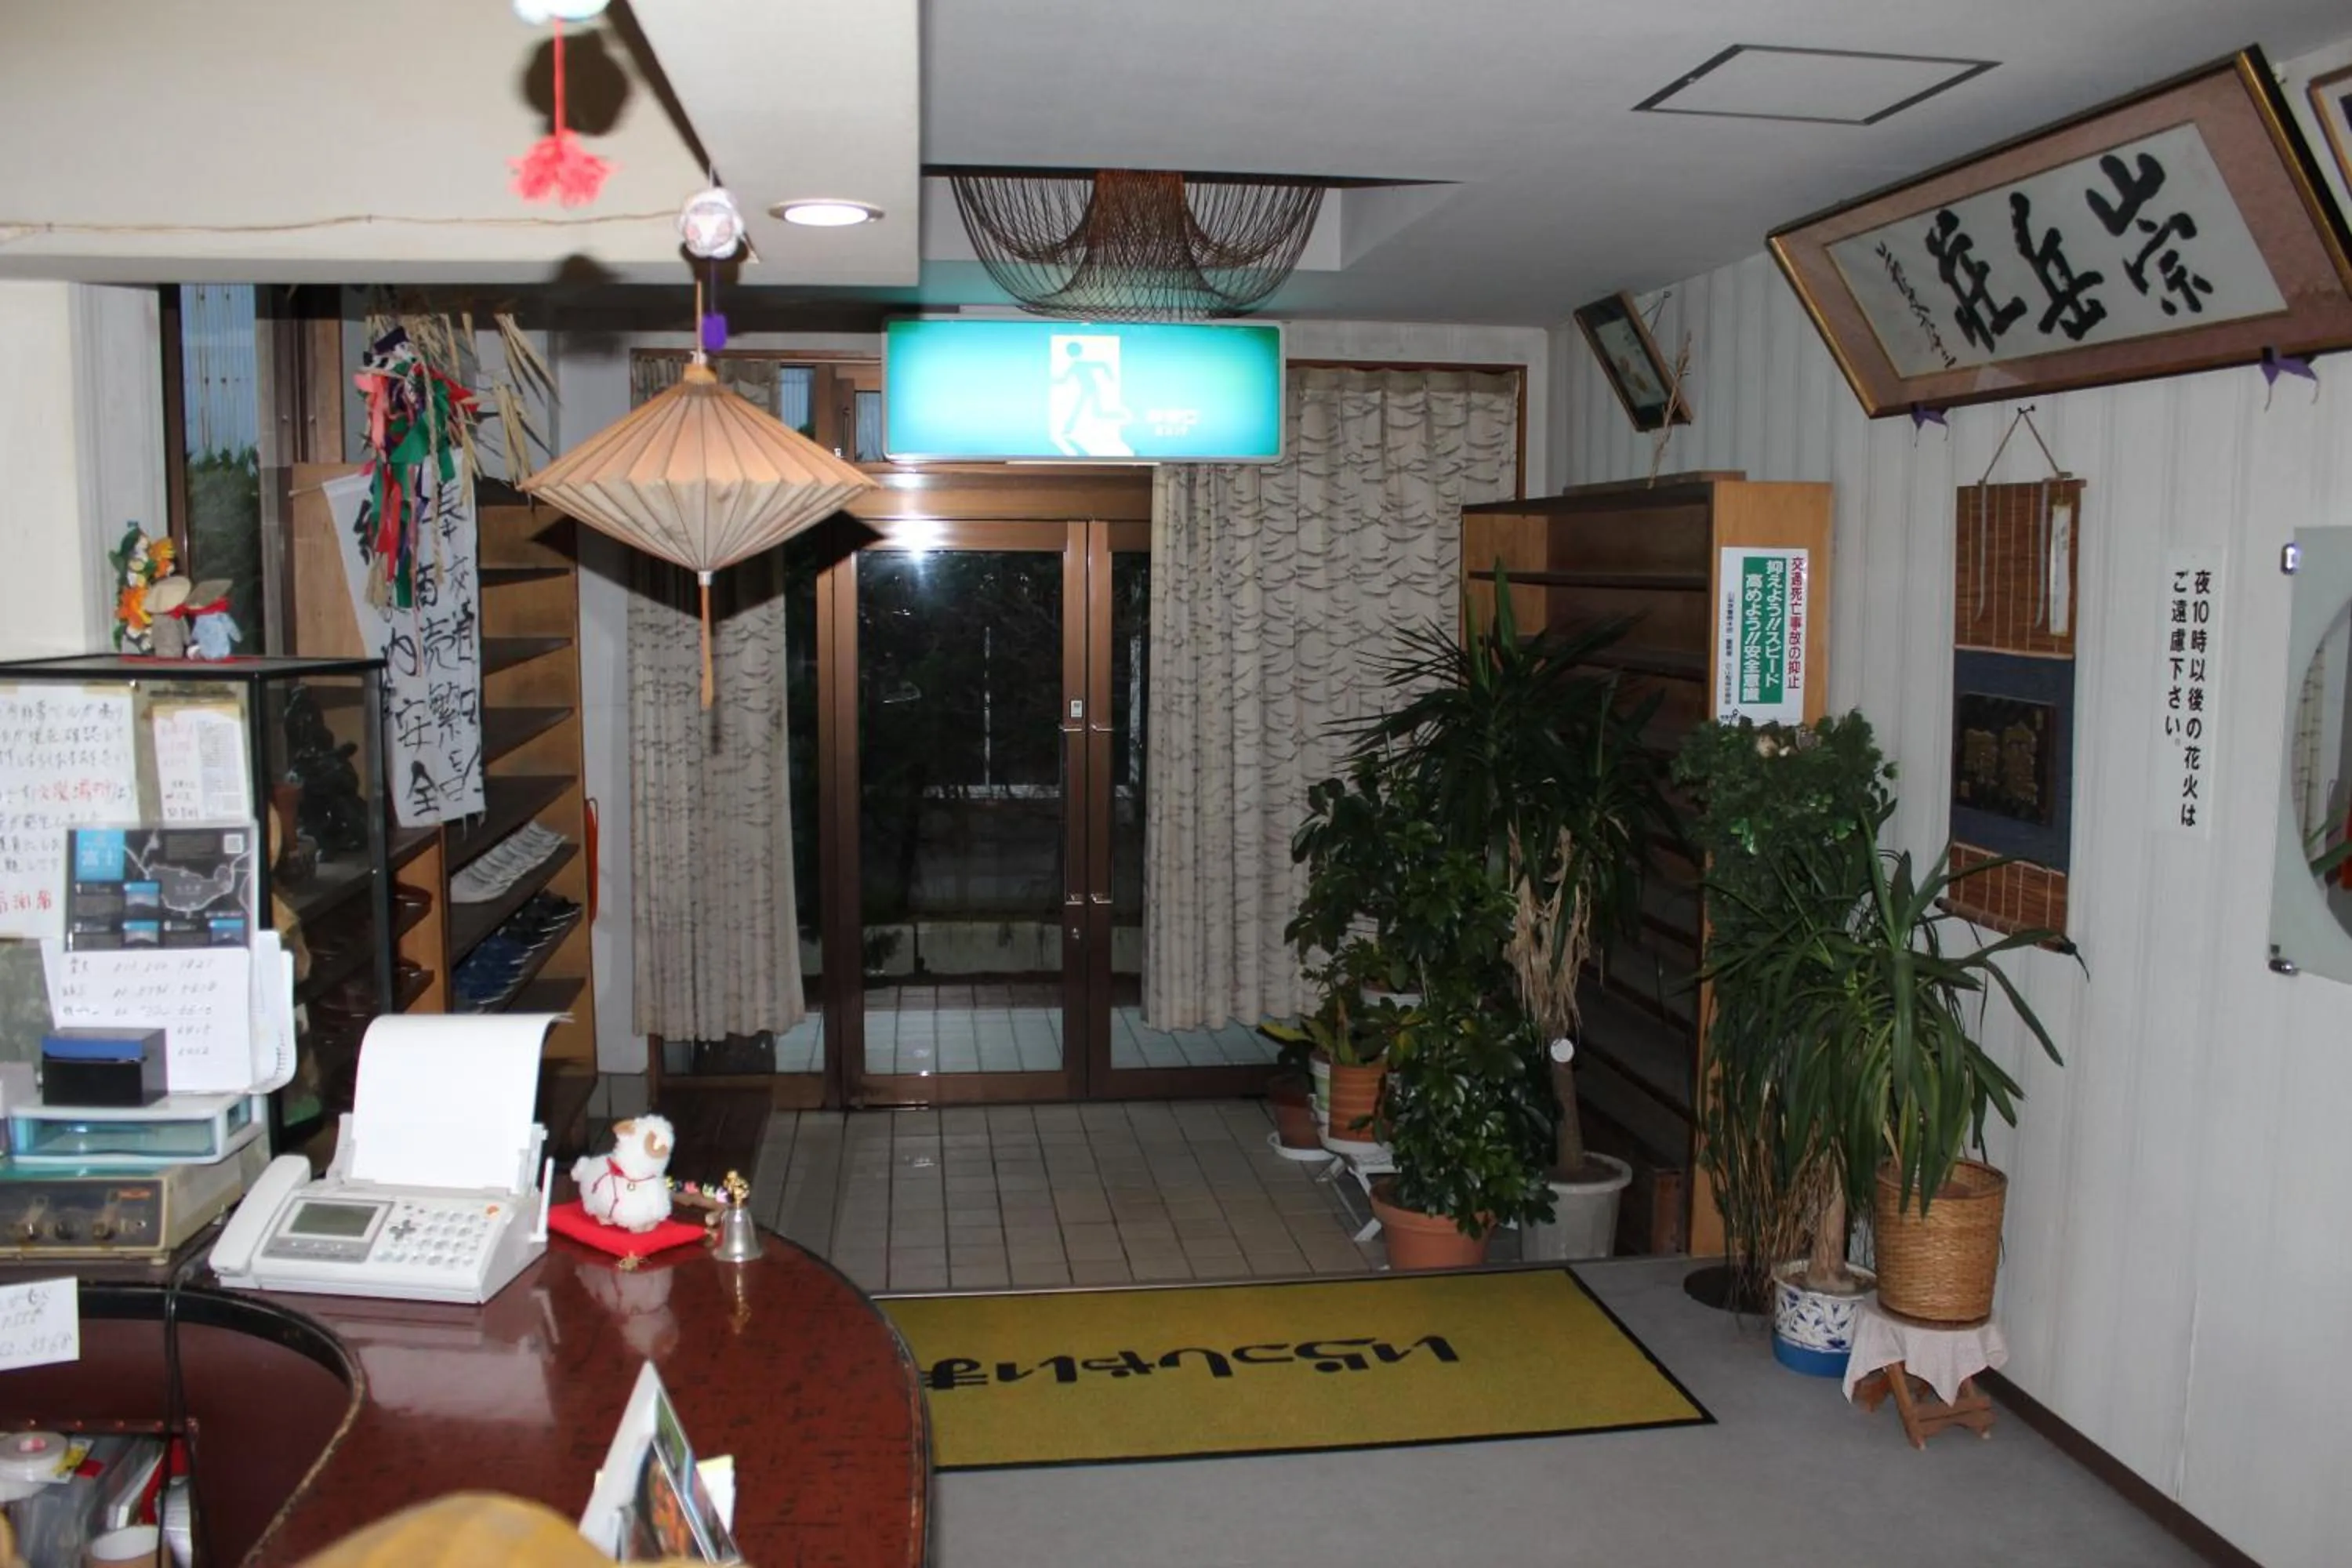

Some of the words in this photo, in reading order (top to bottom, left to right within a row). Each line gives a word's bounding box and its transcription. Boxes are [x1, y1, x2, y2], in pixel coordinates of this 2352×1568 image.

[1788, 557, 1804, 689] 交通死亡事故の抑止
[2180, 570, 2211, 826] 夜10時以後の花火は
